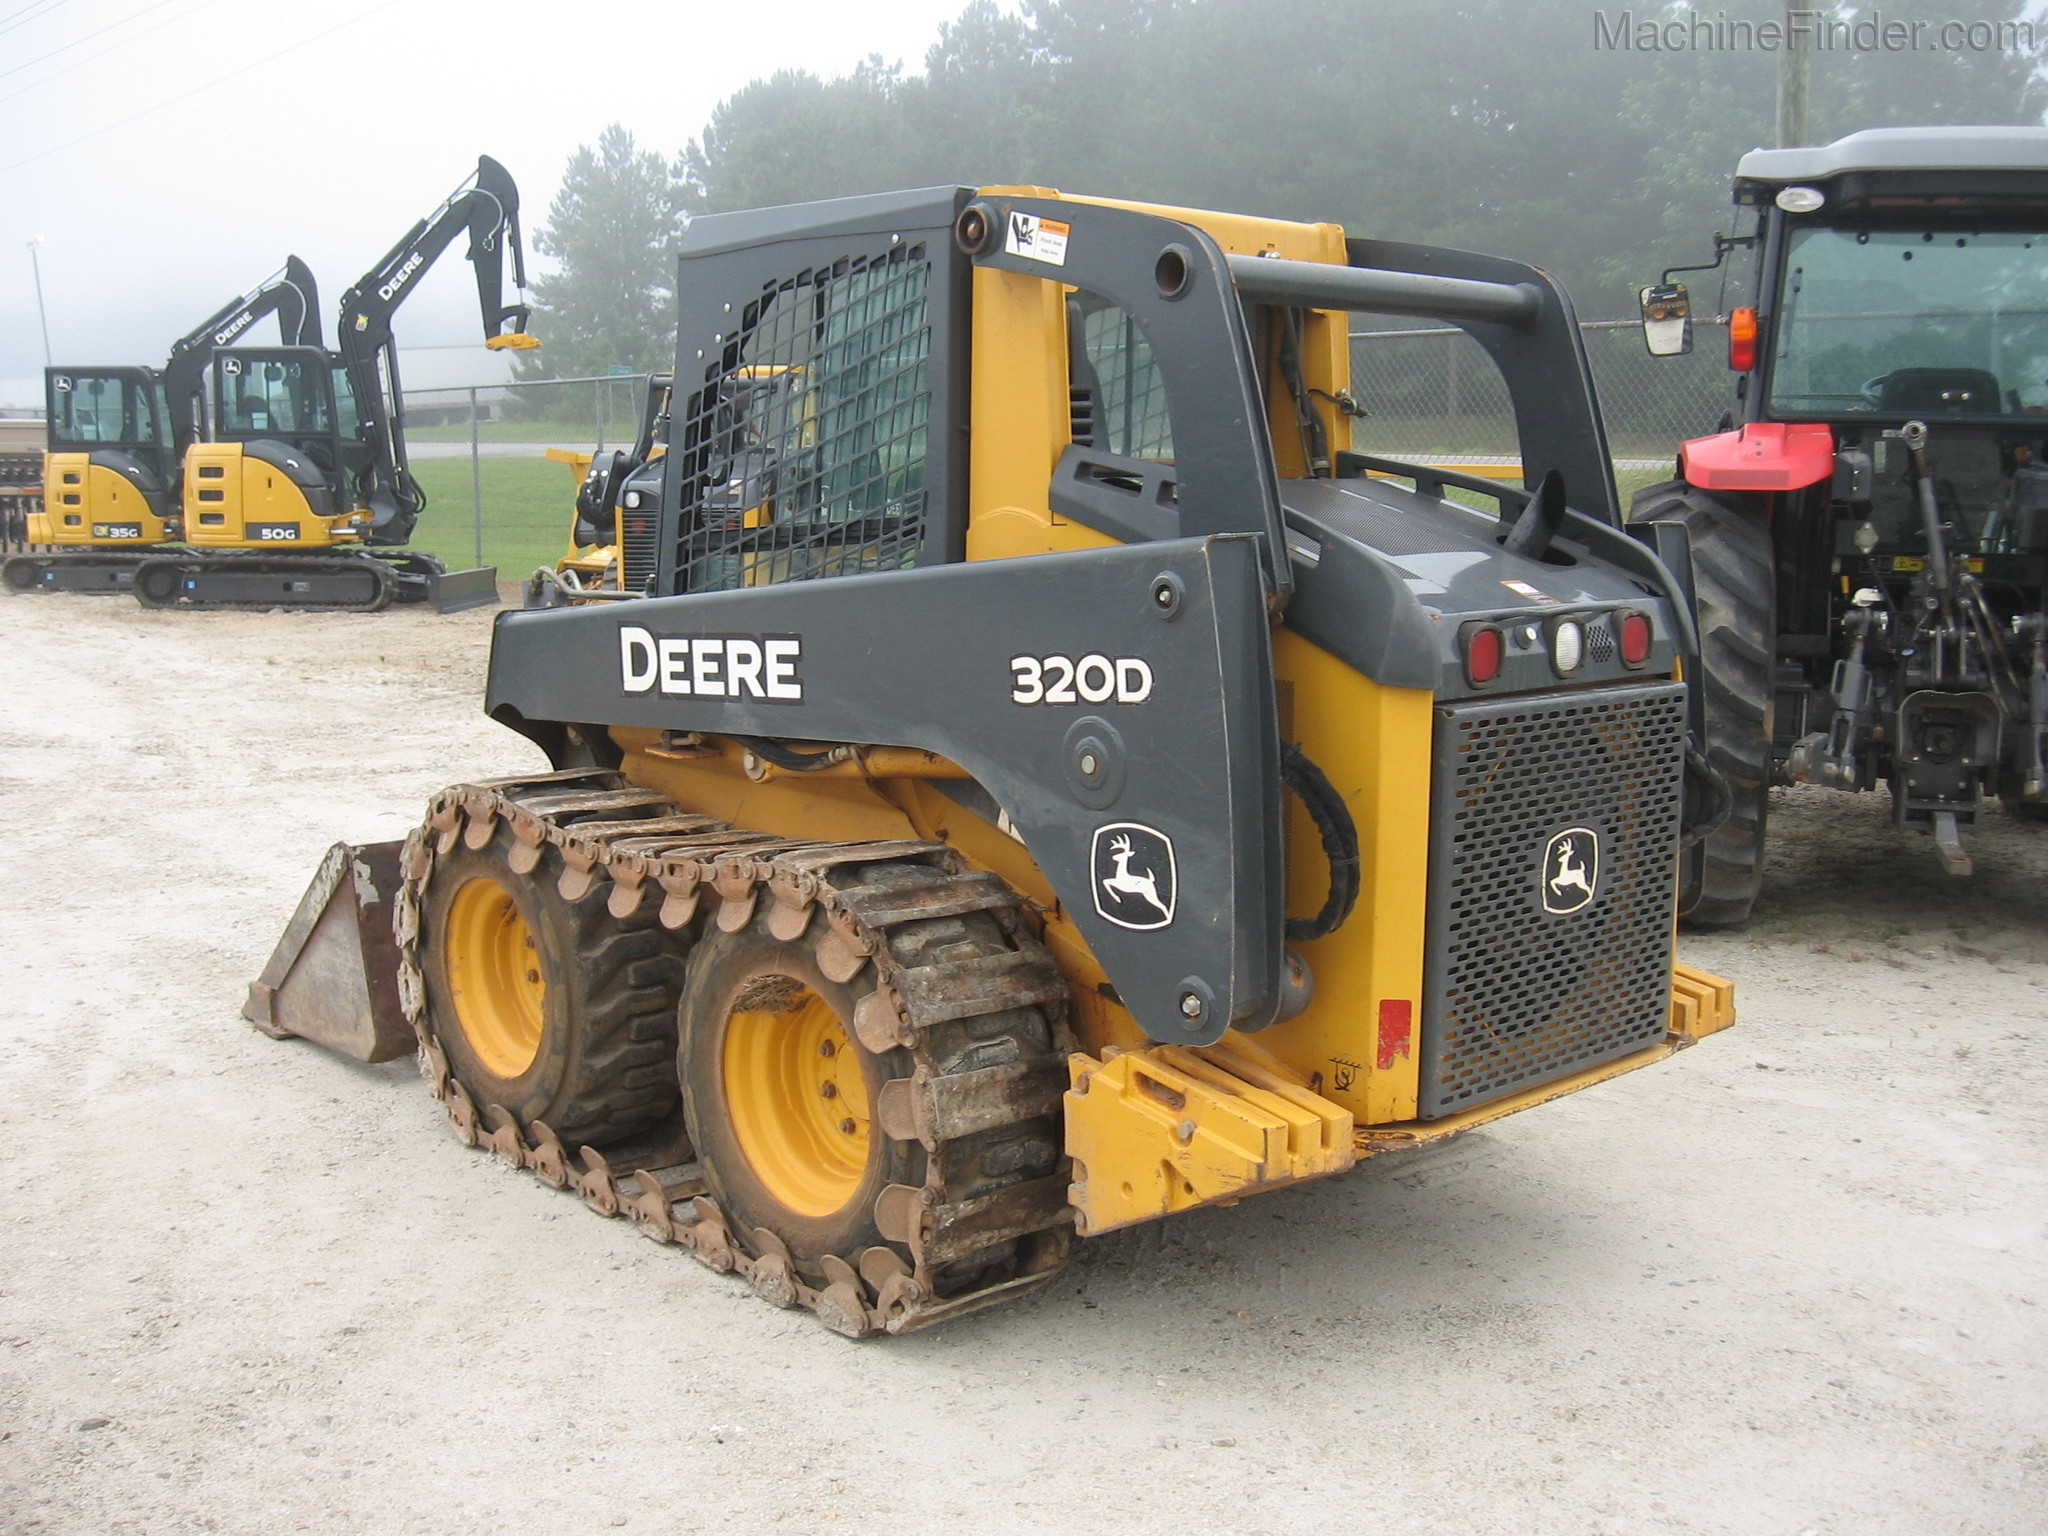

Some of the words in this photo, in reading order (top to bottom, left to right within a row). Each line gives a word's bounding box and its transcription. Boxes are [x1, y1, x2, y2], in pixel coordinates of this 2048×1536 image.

[377, 251, 424, 301] DEERE
[214, 310, 254, 345] DEERE
[109, 527, 139, 538] 35G
[261, 527, 296, 540] 50G
[620, 626, 802, 699] DEERE
[1011, 654, 1153, 704] 320D
